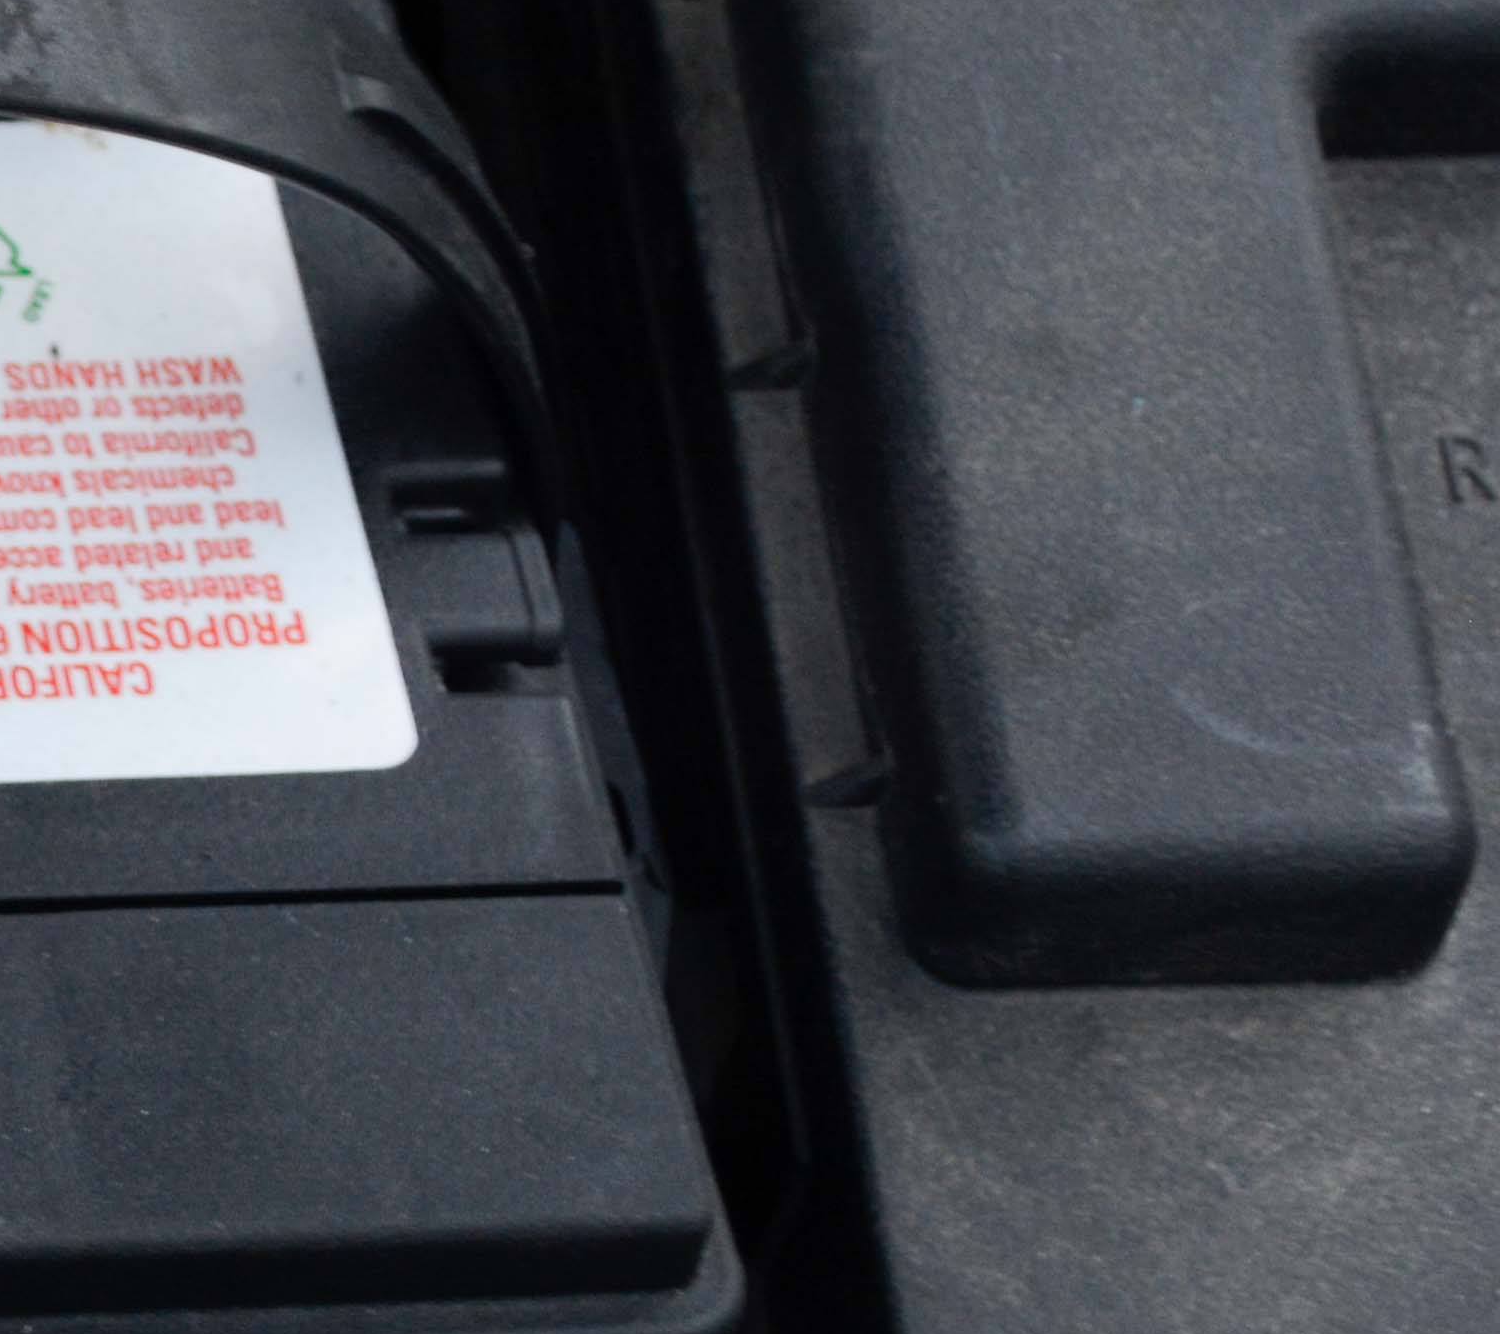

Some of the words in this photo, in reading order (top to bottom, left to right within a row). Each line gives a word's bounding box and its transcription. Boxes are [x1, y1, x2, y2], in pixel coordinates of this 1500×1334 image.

[4, 361, 124, 392] HANDS
[134, 356, 242, 386] WASH
[1, 397, 82, 425] other
[92, 395, 122, 418] or
[132, 392, 244, 423] defects
[63, 432, 94, 460] to
[102, 428, 256, 459] California
[73, 464, 235, 497] chemicals
[67, 506, 137, 535] lead
[146, 503, 204, 531] and
[214, 499, 285, 529] lead
[74, 541, 185, 572] related
[196, 537, 252, 566] and
[8, 578, 119, 610] battery
[126, 574, 284, 606] Batteries,
[20, 611, 307, 655] PROPOSITION
